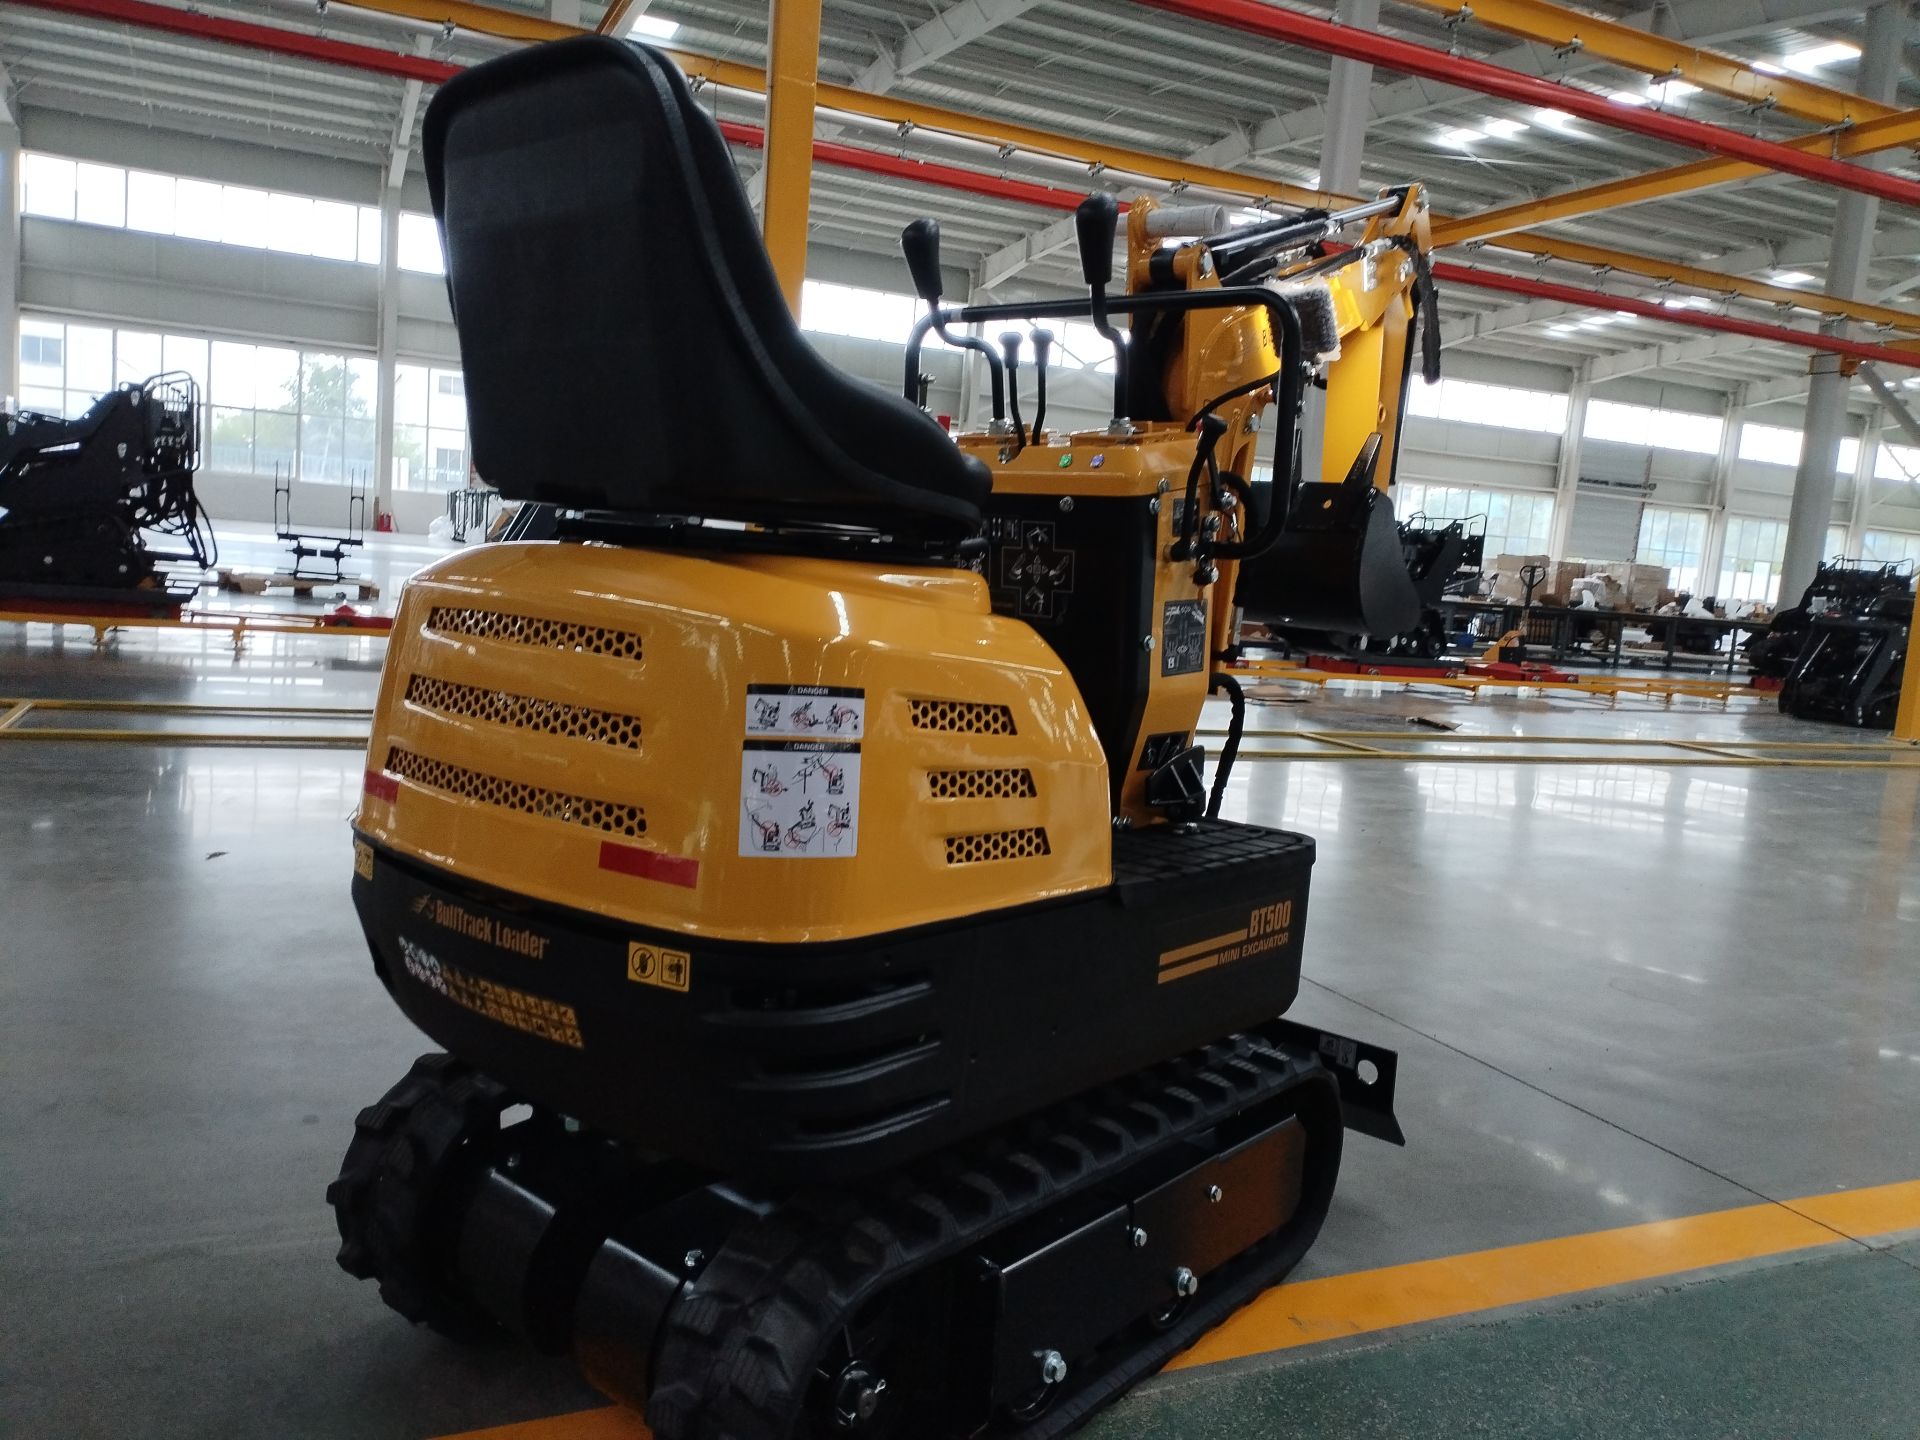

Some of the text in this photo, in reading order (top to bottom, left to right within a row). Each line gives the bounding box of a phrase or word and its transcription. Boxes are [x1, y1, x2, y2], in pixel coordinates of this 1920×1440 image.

[797, 686, 829, 696] DANGER
[793, 742, 825, 751] DANGER
[436, 900, 545, 960] BullTrack Loader
[1250, 900, 1292, 938] BT500
[1219, 932, 1288, 966] MINI EXCAVATOR
